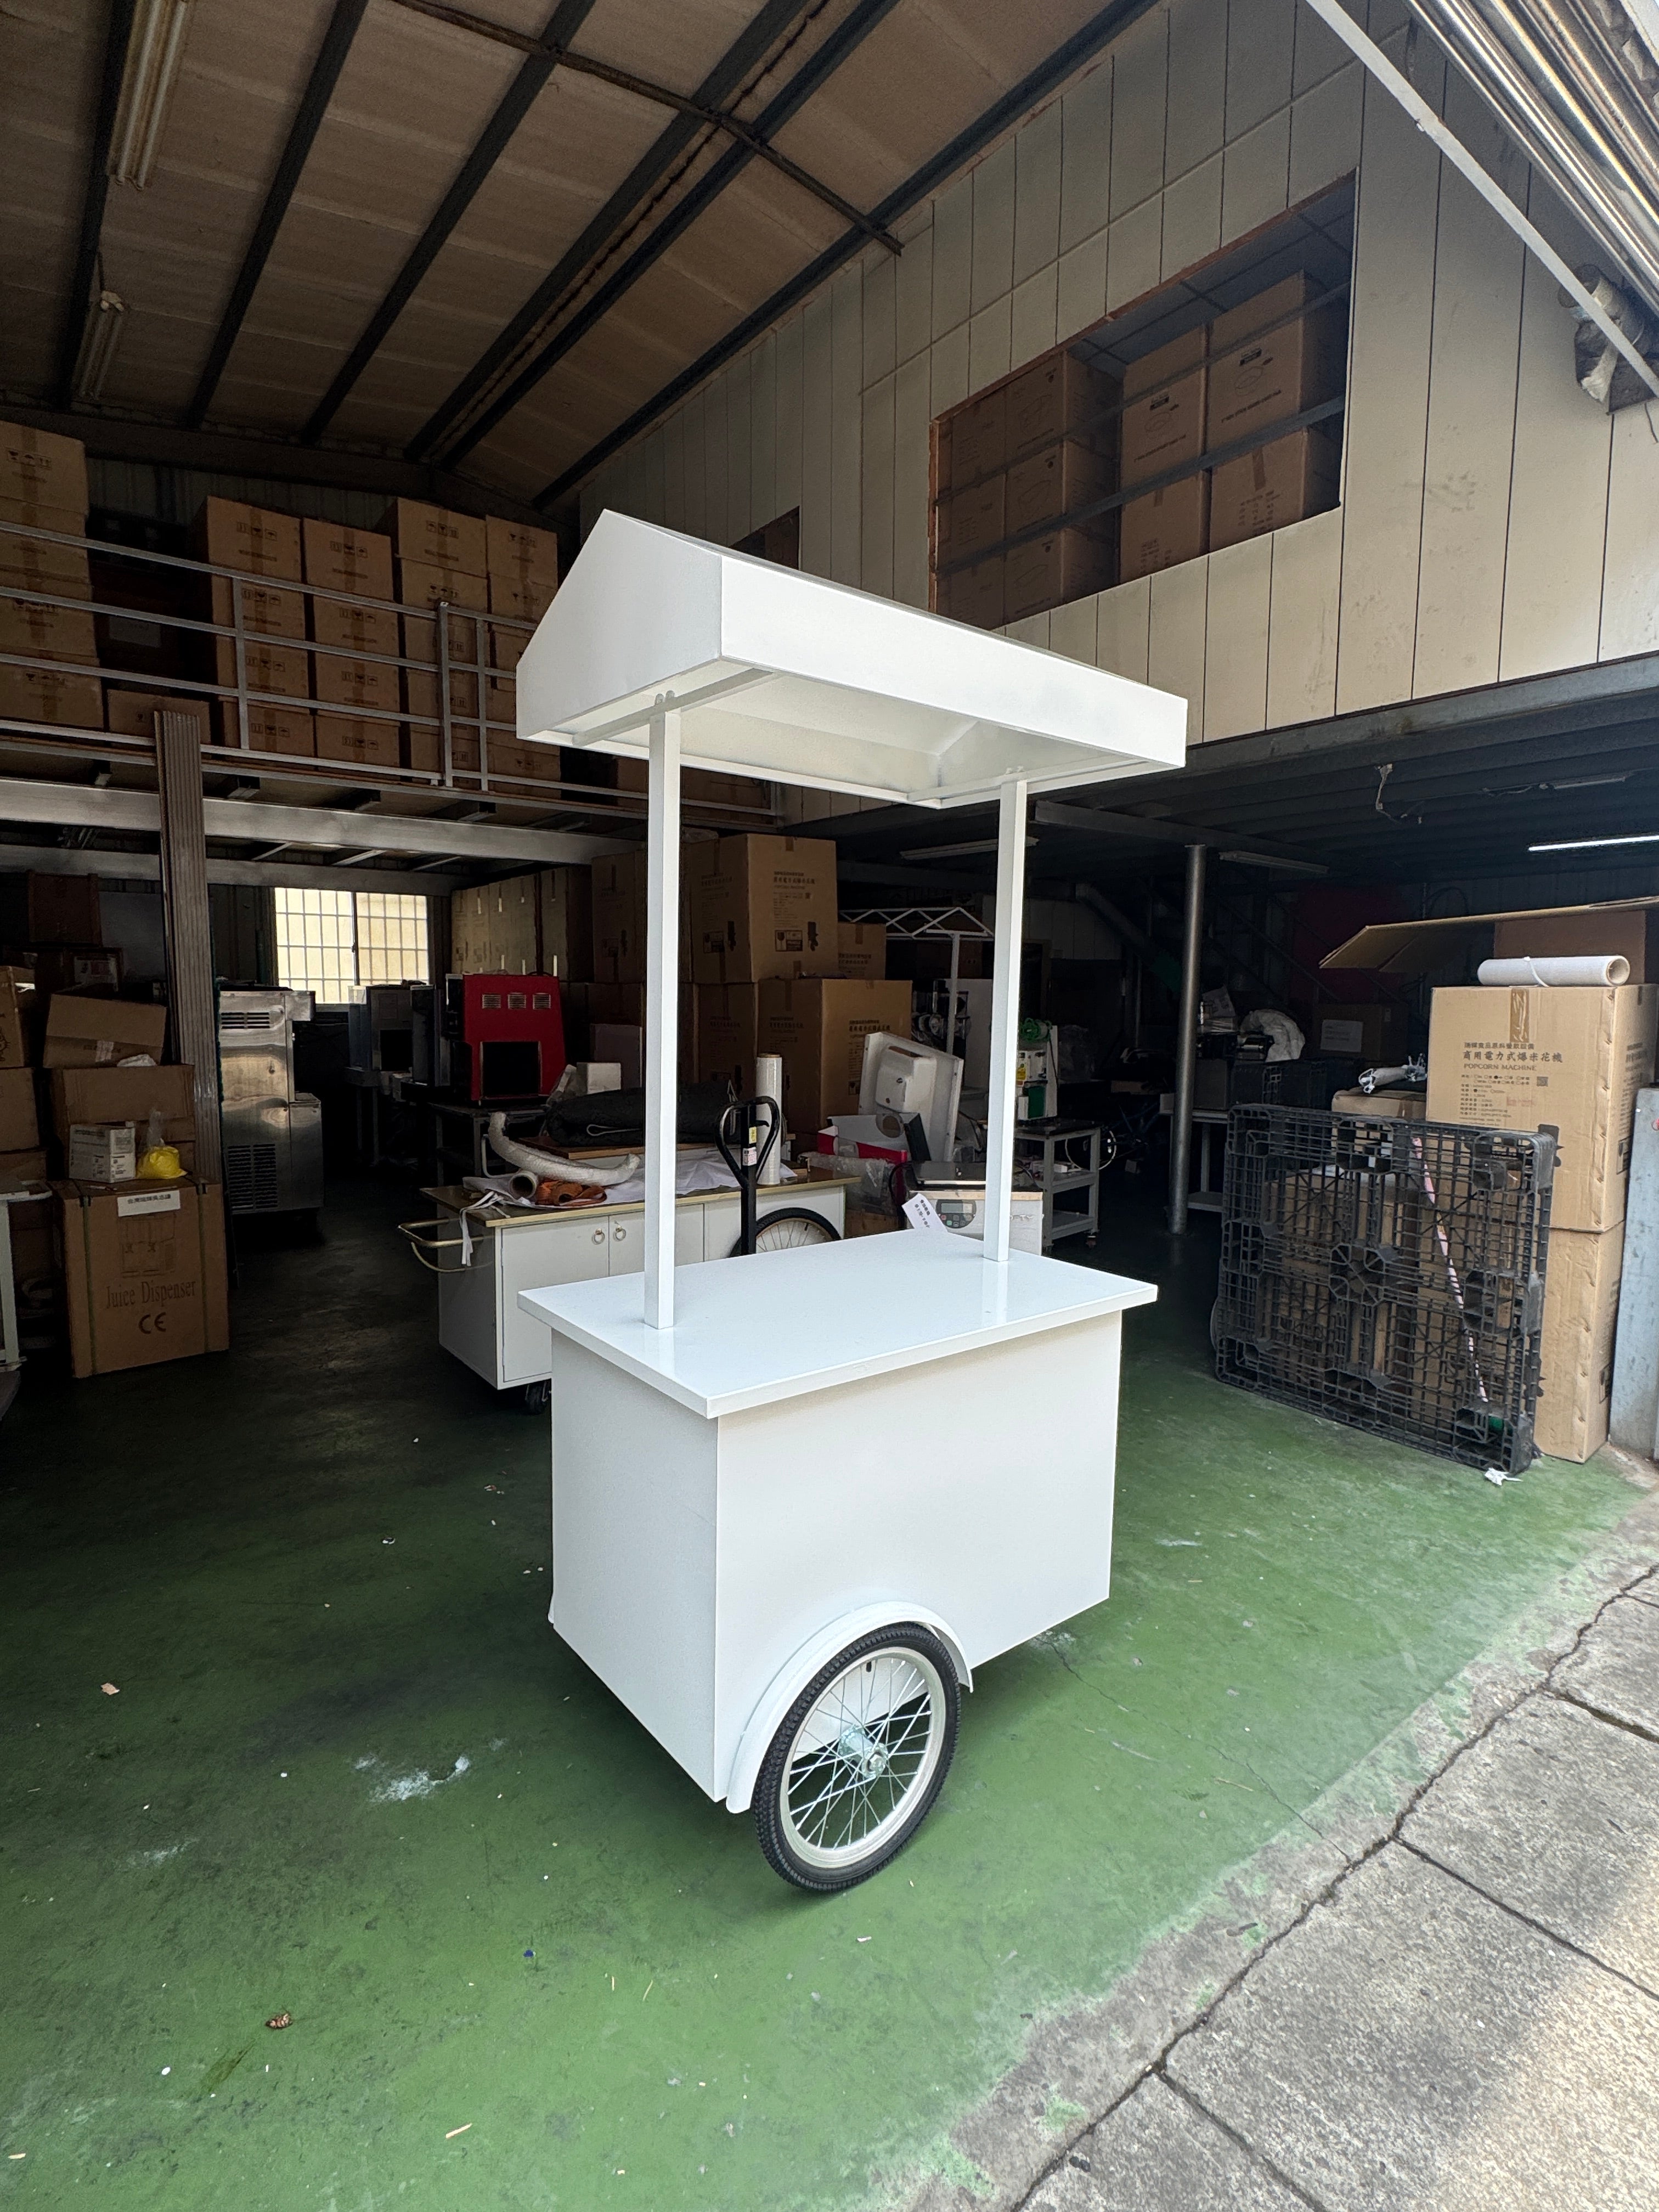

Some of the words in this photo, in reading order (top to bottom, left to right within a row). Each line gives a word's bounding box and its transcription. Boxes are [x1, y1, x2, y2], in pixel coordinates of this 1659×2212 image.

[1463, 1051, 1562, 1063] 商用電力式爆米花機
[106, 1285, 136, 1309] Juice
[141, 1280, 196, 1307] Dispenser
[139, 1312, 166, 1334] CE
